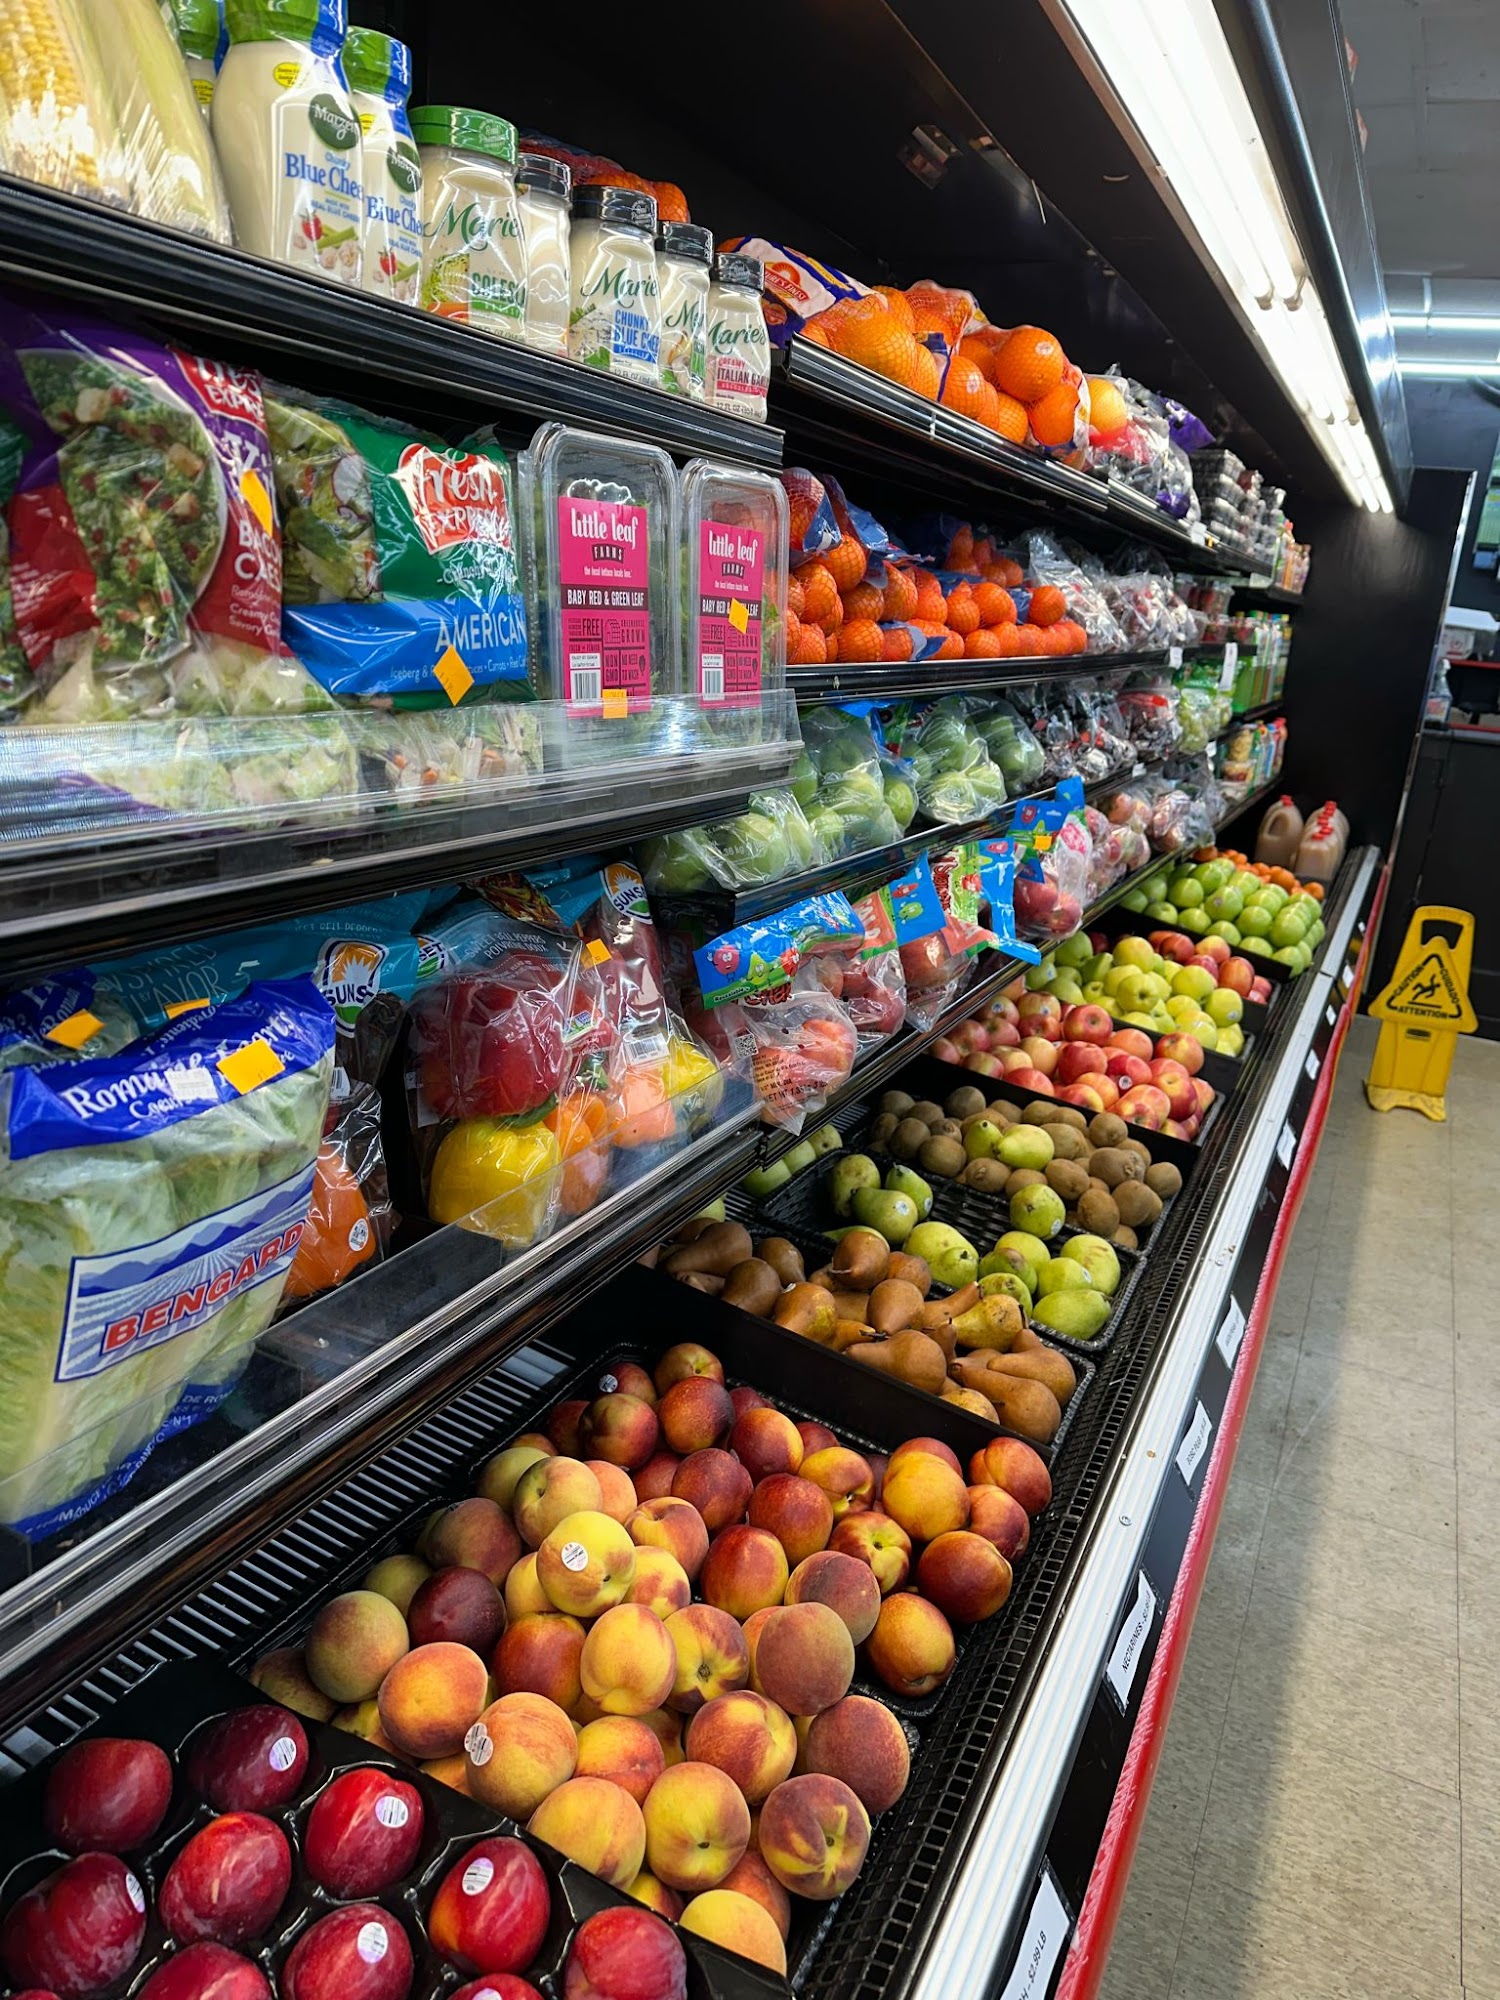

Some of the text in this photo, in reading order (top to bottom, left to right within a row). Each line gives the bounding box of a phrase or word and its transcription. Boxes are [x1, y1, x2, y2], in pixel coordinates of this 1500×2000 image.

[285, 153, 326, 187] Blue
[366, 196, 400, 226] Blue
[786, 282, 808, 302] FINEST
[615, 309, 649, 331] CHUNKY
[614, 325, 638, 347] BLUE
[718, 357, 746, 369] CREAMY
[717, 367, 750, 385] ITALIAN
[571, 507, 639, 550] little leaf
[708, 529, 758, 568] little leaf
[567, 589, 644, 607] BABY RED & GREEN LEAF
[702, 598, 759, 617] BABY RED LEAF
[434, 610, 527, 653] AMERICAN
[582, 618, 600, 637] FREE
[621, 628, 645, 643] GROWN
[605, 654, 618, 668] NON
[390, 666, 420, 684] Iceberg
[605, 668, 619, 682] GMO
[1393, 963, 1424, 996] CAUTION
[1440, 967, 1460, 1004] CUIDADO
[1398, 1005, 1449, 1019] ATTENTION
[101, 1219, 307, 1355] BENGARD
[1121, 1622, 1144, 1674] NECTARINES
[1037, 1930, 1047, 1950] LB
